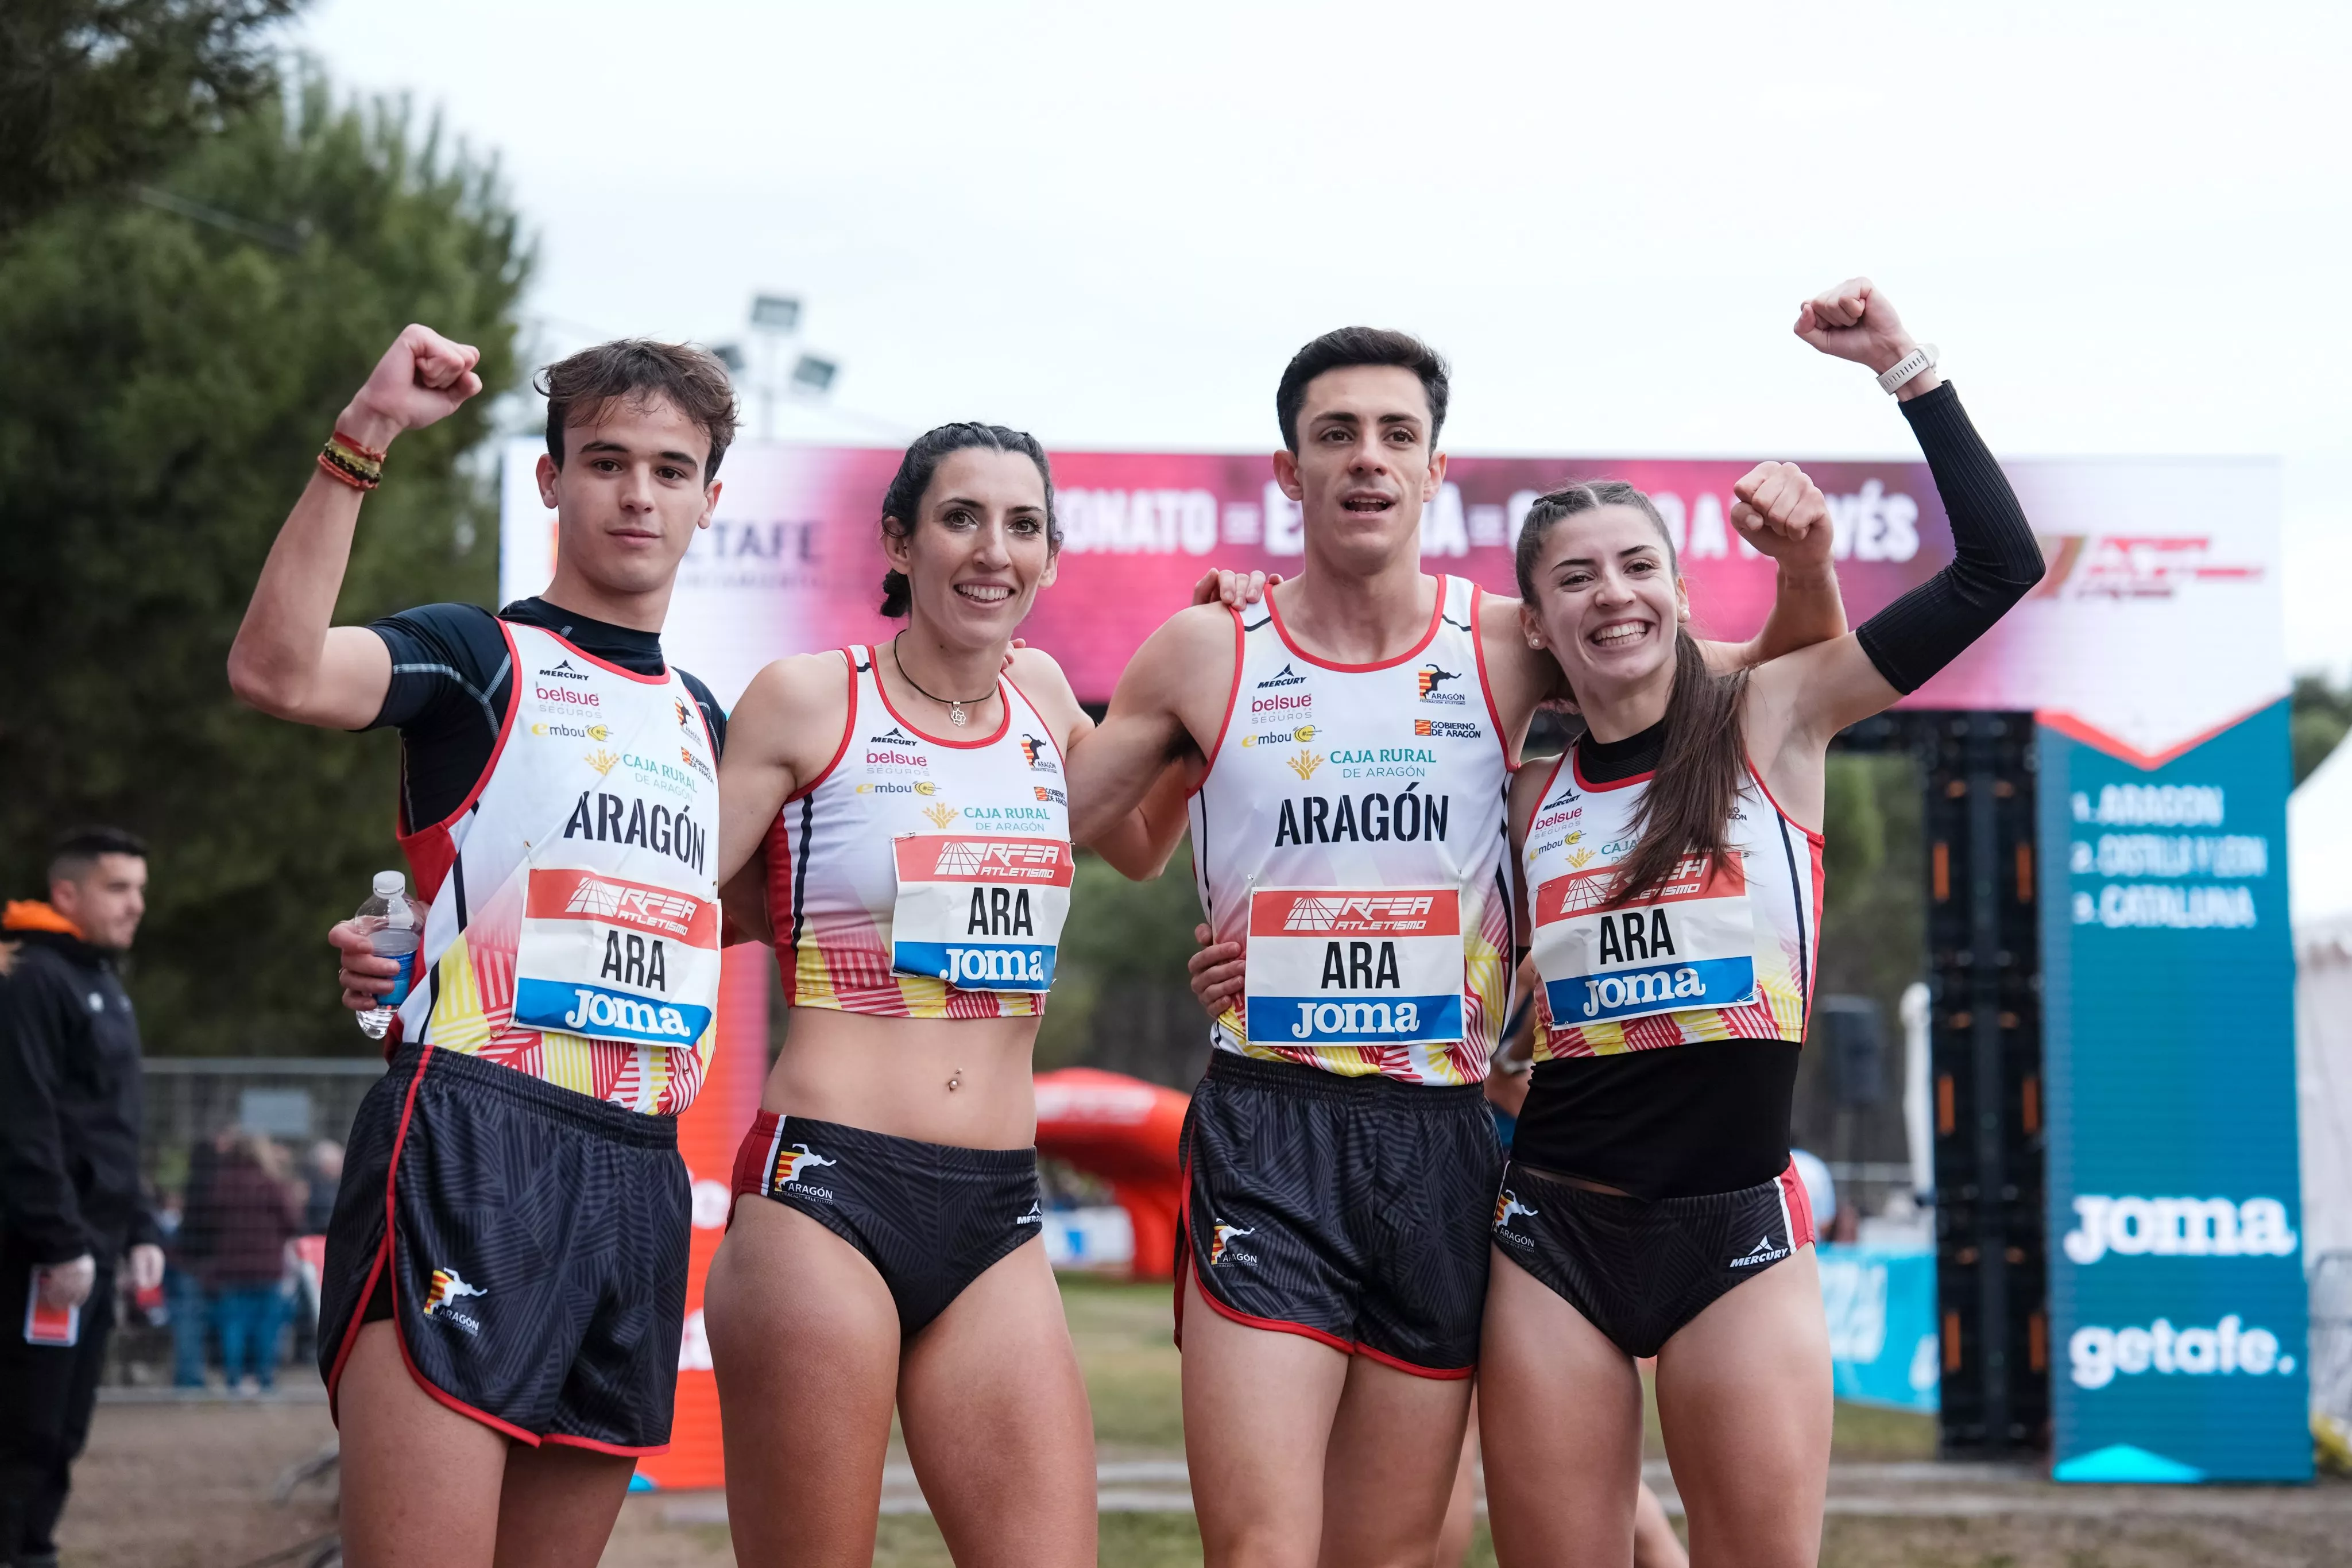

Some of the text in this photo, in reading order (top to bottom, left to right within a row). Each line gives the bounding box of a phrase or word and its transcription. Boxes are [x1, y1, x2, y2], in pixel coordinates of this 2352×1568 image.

[539, 669, 590, 681] MERCURY
[1256, 676, 1307, 689] MERCURY
[1432, 692, 1465, 700] ARAGÓN
[1251, 712, 1312, 725] SEGUROS
[1431, 721, 1476, 730] GOBIERNO
[531, 723, 586, 738] embou
[1446, 730, 1481, 738] ARAGON
[871, 737, 918, 746] MERCURY
[1241, 731, 1291, 748] embou
[1330, 749, 1437, 764] CAJA RURAL
[623, 753, 698, 793] CAJA RURAL
[1343, 766, 1426, 779] DE ARAGÓN
[635, 772, 694, 803] DE ARAGÓN
[856, 782, 912, 794] embou
[1542, 794, 1581, 811] MERCURY
[964, 807, 1051, 820] CAJA RURAL
[1274, 781, 1449, 847] ARAGÓN
[563, 790, 705, 876] ARAGÓN
[976, 821, 1045, 833] DE ARAGÓN
[984, 843, 1059, 867] RFEA
[1530, 839, 1563, 861] embou
[1601, 839, 1638, 855] CAJA
[980, 866, 1055, 879] ATLETISMO
[620, 888, 698, 922] RFEA
[967, 887, 1034, 936] ARA
[1340, 896, 1434, 920] RFEA
[617, 911, 688, 936] ATLETISMO
[1334, 920, 1428, 931] ATLETISMO
[1600, 908, 1676, 965] ARA
[601, 930, 666, 992] ARA
[1321, 942, 1401, 989] ARA
[788, 1183, 833, 1199] ARAGÓN
[1500, 1228, 1534, 1248] ARAGÓN
[1223, 1253, 1257, 1263] ARAGÓN
[1729, 1248, 1789, 1268] MERCURY
[440, 1308, 479, 1331] ARAGÓN
